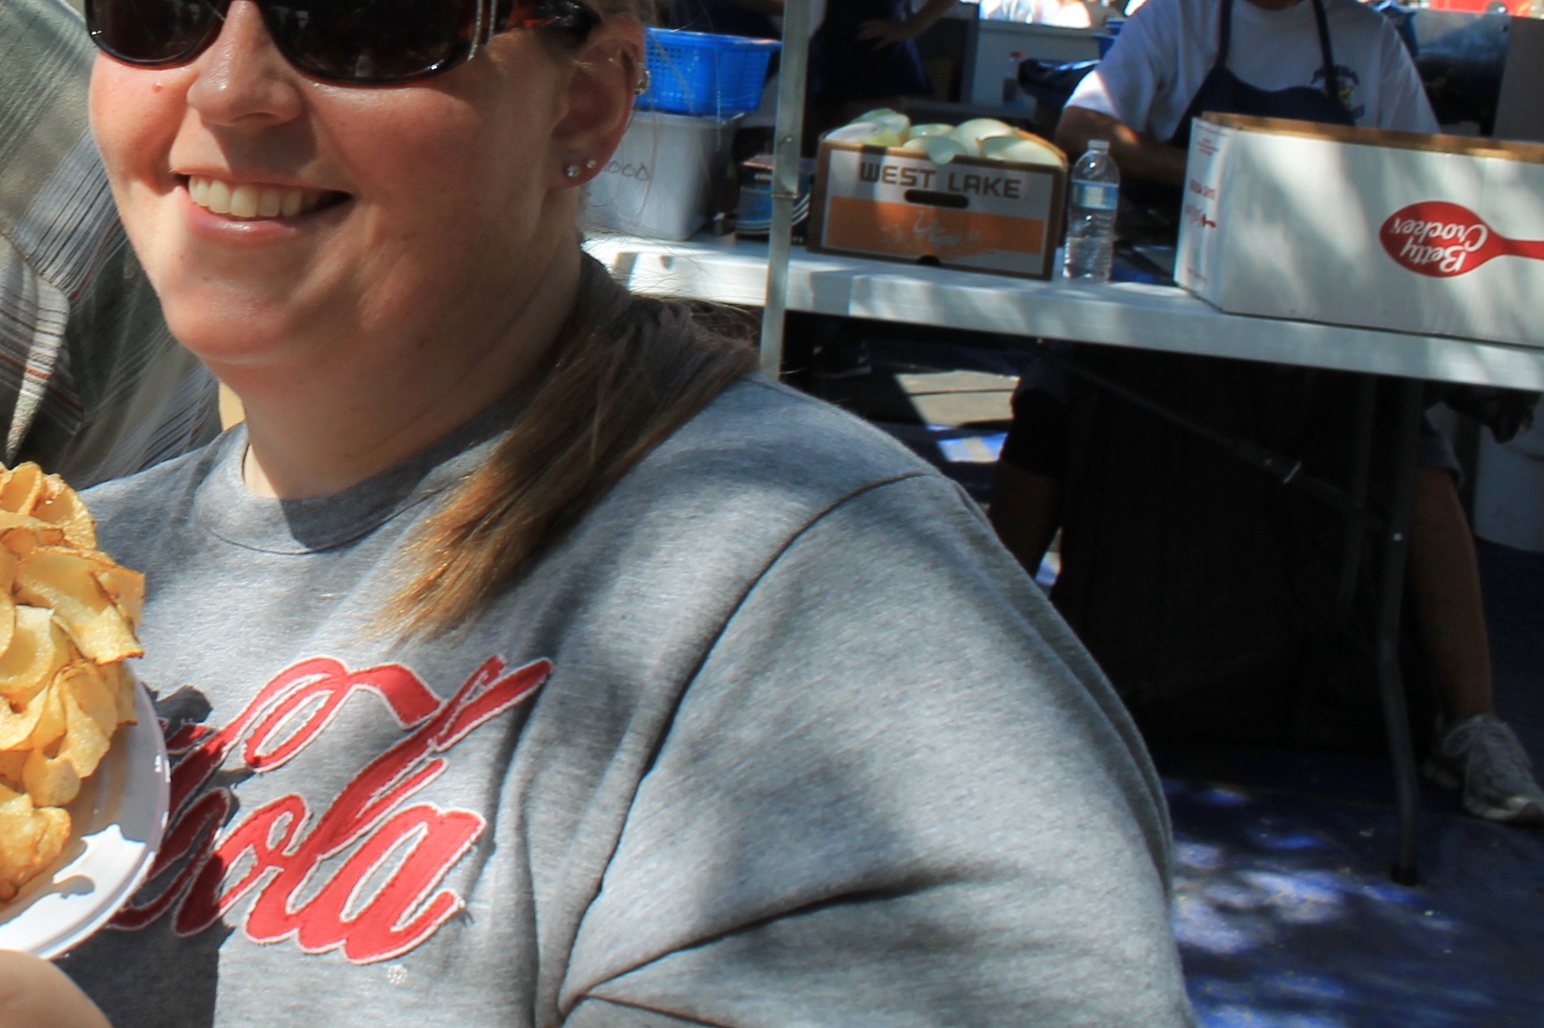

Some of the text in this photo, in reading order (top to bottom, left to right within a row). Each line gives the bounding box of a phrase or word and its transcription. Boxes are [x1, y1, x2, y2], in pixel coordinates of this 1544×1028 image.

[859, 161, 1021, 200] WEST LAKE
[1391, 218, 1488, 251] Crocker
[1400, 237, 1467, 272] Betty
